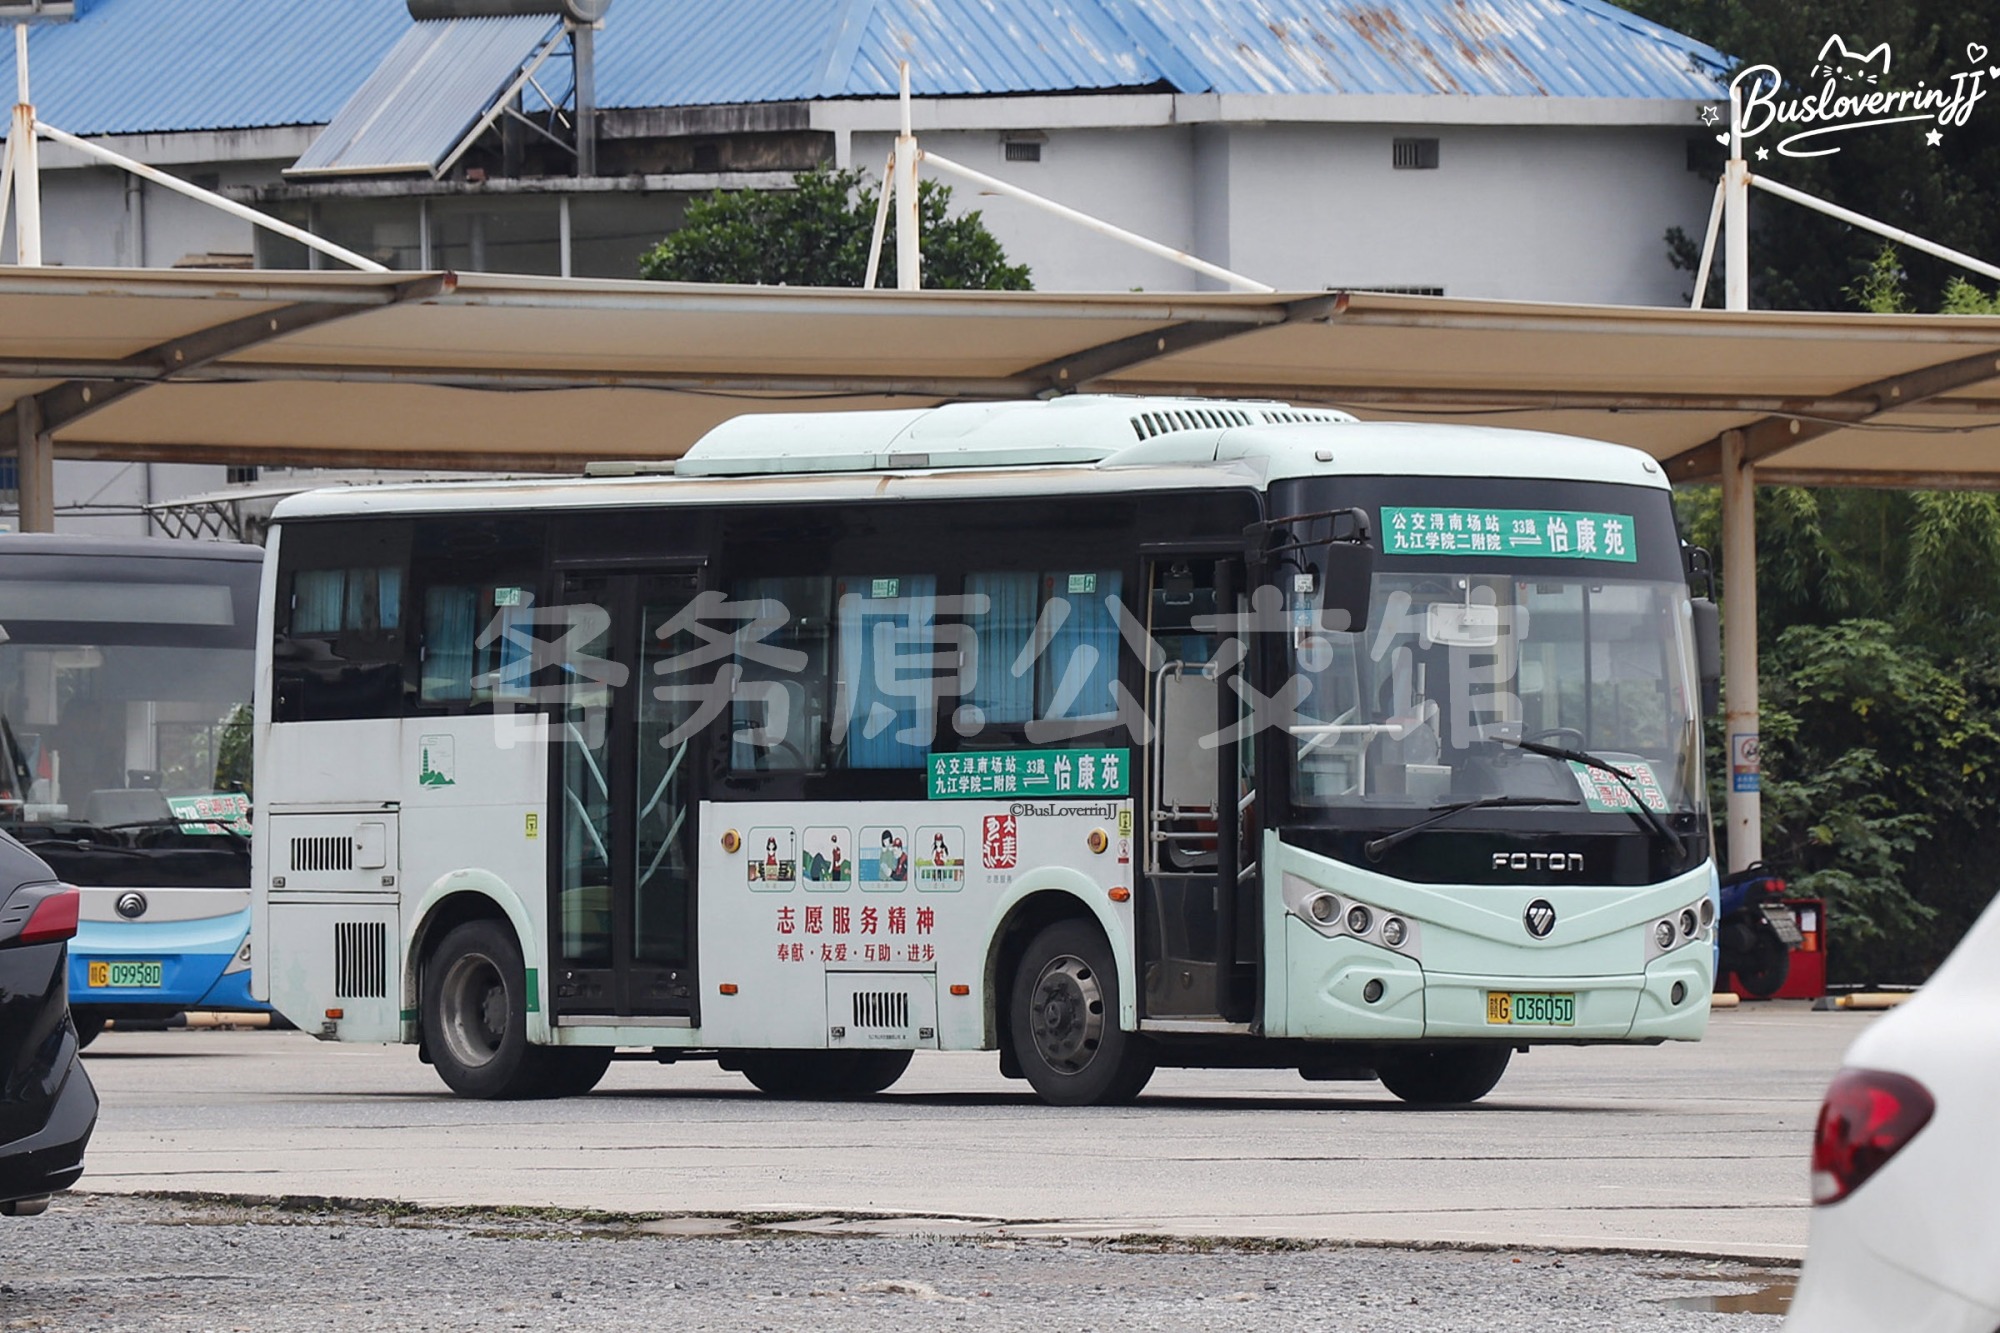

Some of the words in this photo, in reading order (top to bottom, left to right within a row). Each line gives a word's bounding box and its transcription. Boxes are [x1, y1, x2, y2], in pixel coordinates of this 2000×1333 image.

[1392, 513, 1500, 532] 公交浔南场站
[1512, 519, 1537, 535] 33路
[1394, 532, 1502, 551] 九江学院二附院
[1546, 516, 1625, 555] 怡康苑
[935, 756, 1017, 775] 公交浔南场站
[1054, 754, 1120, 791] 怡康苑
[935, 775, 1017, 794] 九江学院二附院
[1492, 853, 1584, 871] FOTON
[777, 906, 935, 935] 志愿服务精神
